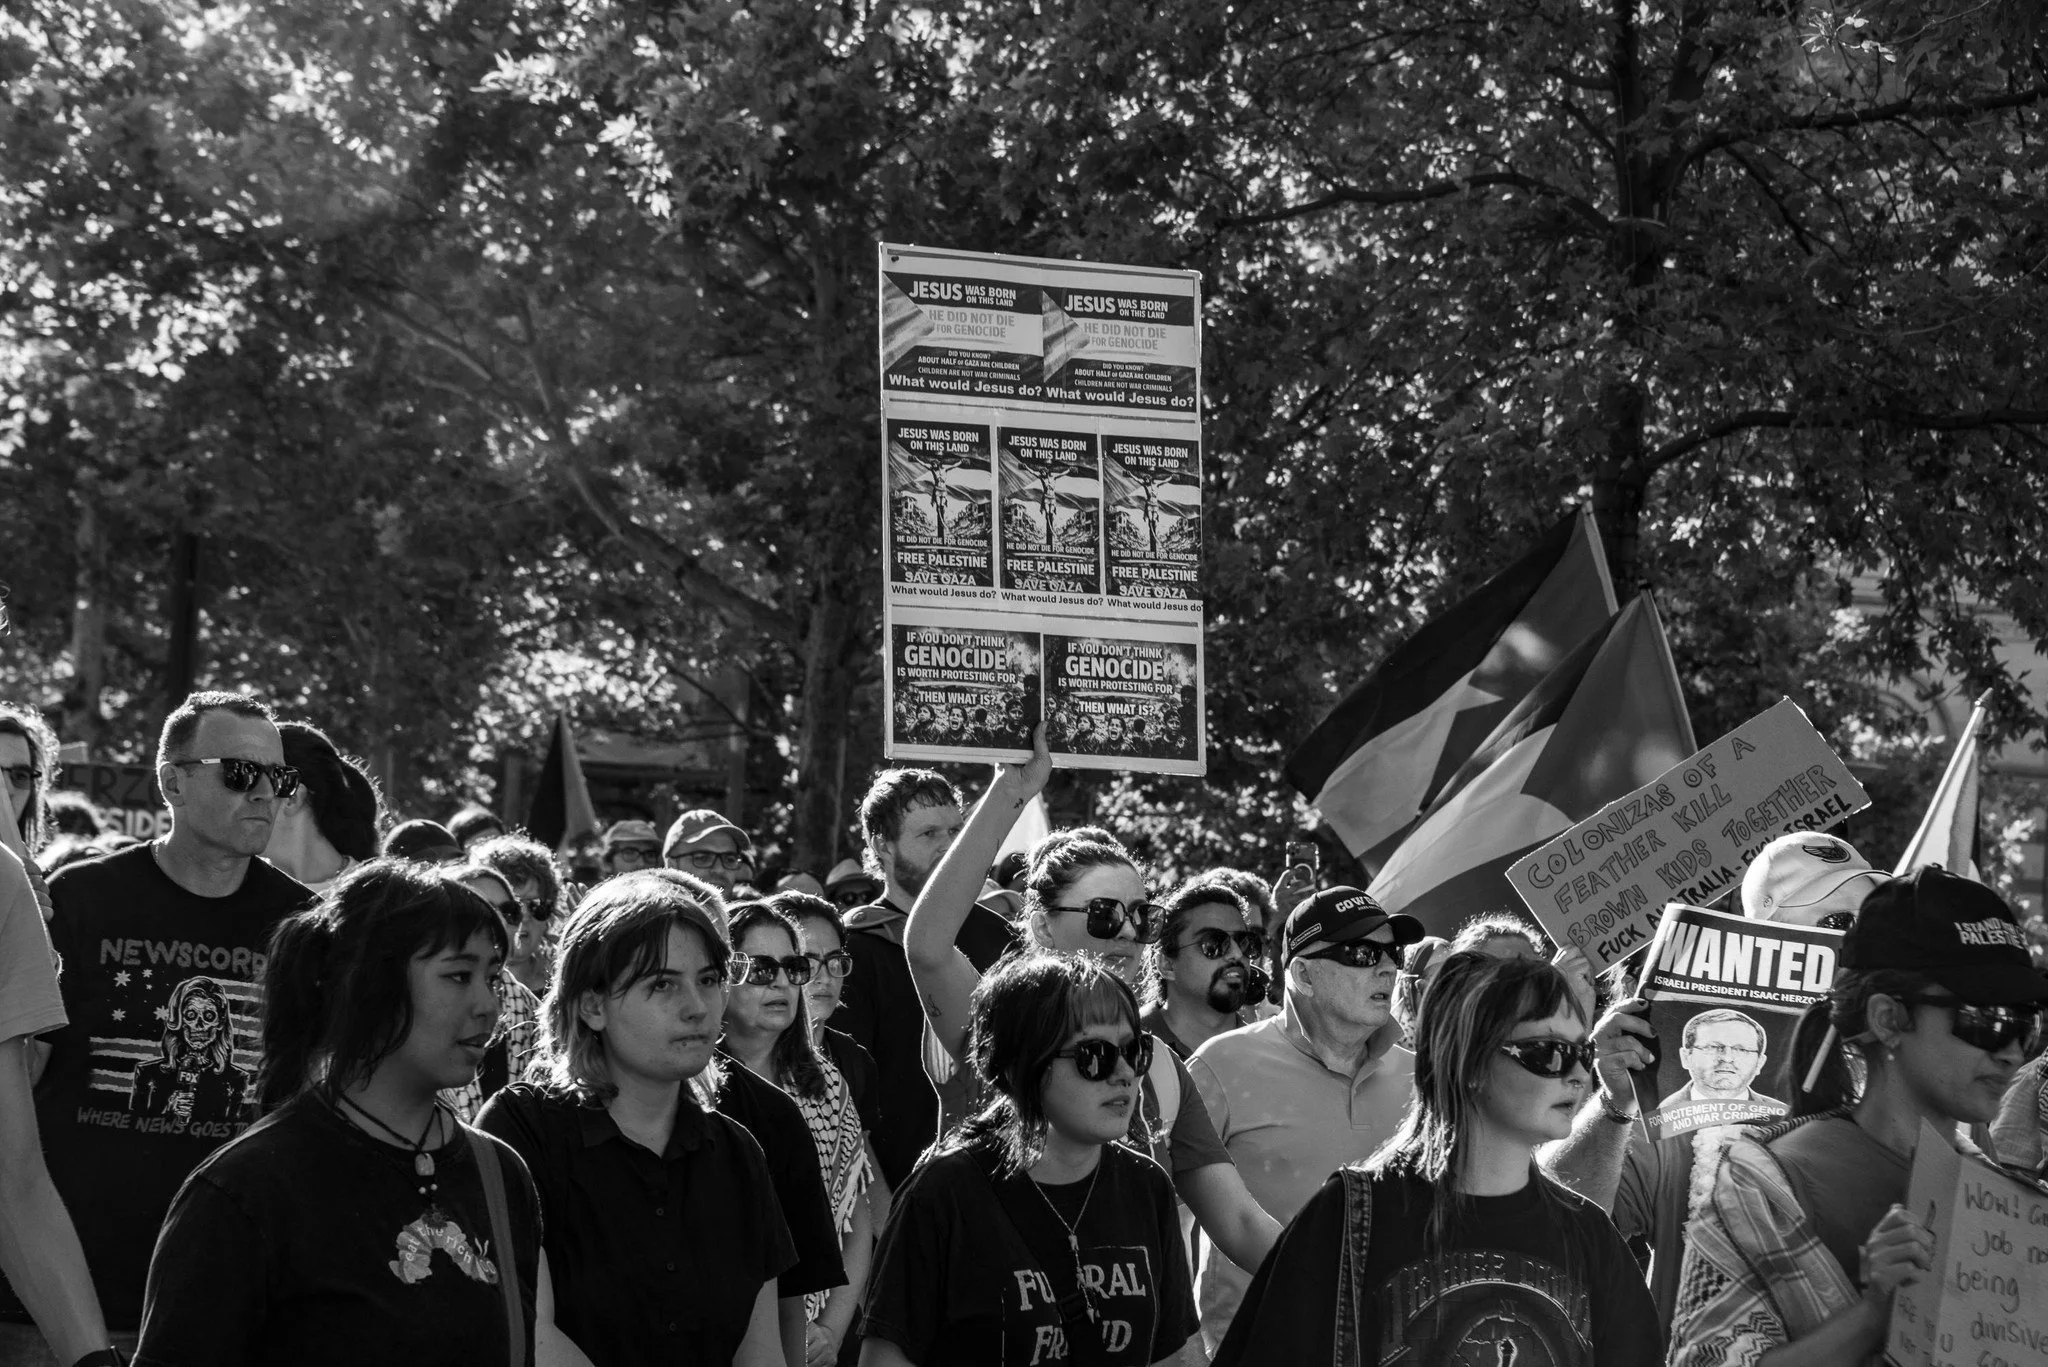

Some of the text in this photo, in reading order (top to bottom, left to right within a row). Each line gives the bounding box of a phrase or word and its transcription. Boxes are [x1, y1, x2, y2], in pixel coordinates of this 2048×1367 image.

[909, 281, 1016, 301] JESUS WAS BORN
[996, 298, 1013, 307] LAND
[1065, 295, 1168, 313] JESUS WAS BORN
[929, 310, 1014, 326] HE DID NOT DIE
[1131, 310, 1145, 318] THIS
[1147, 311, 1165, 319] LAND
[937, 324, 1006, 337] FOR GENOCIDE
[1084, 322, 1166, 339] HE DID NOT DIE
[1092, 337, 1158, 350] FOR GENOCIDE
[918, 356, 939, 364] ABOUT
[991, 362, 1020, 370] CHILDREN
[918, 367, 947, 375] CHILDREN
[989, 372, 1020, 381] CRIMINALS
[889, 374, 1042, 396] What would Jesus do?
[1046, 387, 1194, 407] What would Jesus do?
[898, 428, 979, 442] JESUS WAS BORN
[1009, 435, 1086, 451] JESUS WAS BORN
[910, 441, 969, 452] ON THIS LAND
[1021, 448, 1077, 461] ON THIS LAND
[944, 537, 956, 545] FOR
[958, 539, 987, 547] GENOCIDE
[898, 552, 987, 568] FREE PALESTINE
[1007, 559, 1095, 575] FREE PALESTINE
[905, 571, 976, 585] SAVE GAZA
[1015, 579, 1083, 593] SAVE GAZA
[892, 585, 916, 594] What
[919, 588, 948, 596] would
[951, 589, 976, 597] Jesus
[1001, 592, 1026, 601] What
[1028, 595, 1056, 603] would
[1059, 596, 1084, 604] Jesus
[907, 632, 1005, 647] IF YOU DON'T THINK
[905, 645, 1006, 670] GENOCIDE
[1068, 643, 1162, 658] IF YOU DON'T THINK
[897, 667, 1015, 683] IS WORTH PROTESTING FOR
[1065, 656, 1163, 680] GENOCIDE
[1058, 677, 1172, 694] IS WORTH PROTESTING FOR
[919, 691, 996, 705] THEN WHAT IS?
[1080, 701, 1154, 716] THEN WHAT IS?
[1528, 736, 1756, 889] COLONIZAS OF A
[1553, 829, 1666, 915] FEATHER
[1671, 784, 1732, 833] KILL
[1568, 884, 1648, 948] BROWN
[1656, 839, 1713, 889] KIDS
[1597, 866, 1736, 963] FUCK ATRALIA
[1953, 922, 1961, 931] I
[1961, 917, 2001, 933] STAND
[101, 938, 267, 977] NEWSCORP
[1658, 920, 1836, 993] WANTED
[1655, 976, 1819, 1005] ISRAELI PRESIDENT ISAAC HERZO
[180, 1071, 200, 1084] FOX
[77, 1107, 131, 1128] WHERE
[135, 1117, 185, 1135] NEWS
[189, 1121, 231, 1138] GOES
[1649, 1103, 1786, 1128] FOR INCITEMENT OF GENO
[1672, 1111, 1770, 1131] AND WAR CRIMES
[405, 1224, 472, 1264] eat the rich
[1013, 1262, 1146, 1311] FURAL
[1956, 1261, 2020, 1314] being
[1029, 1319, 1133, 1367] FRD
